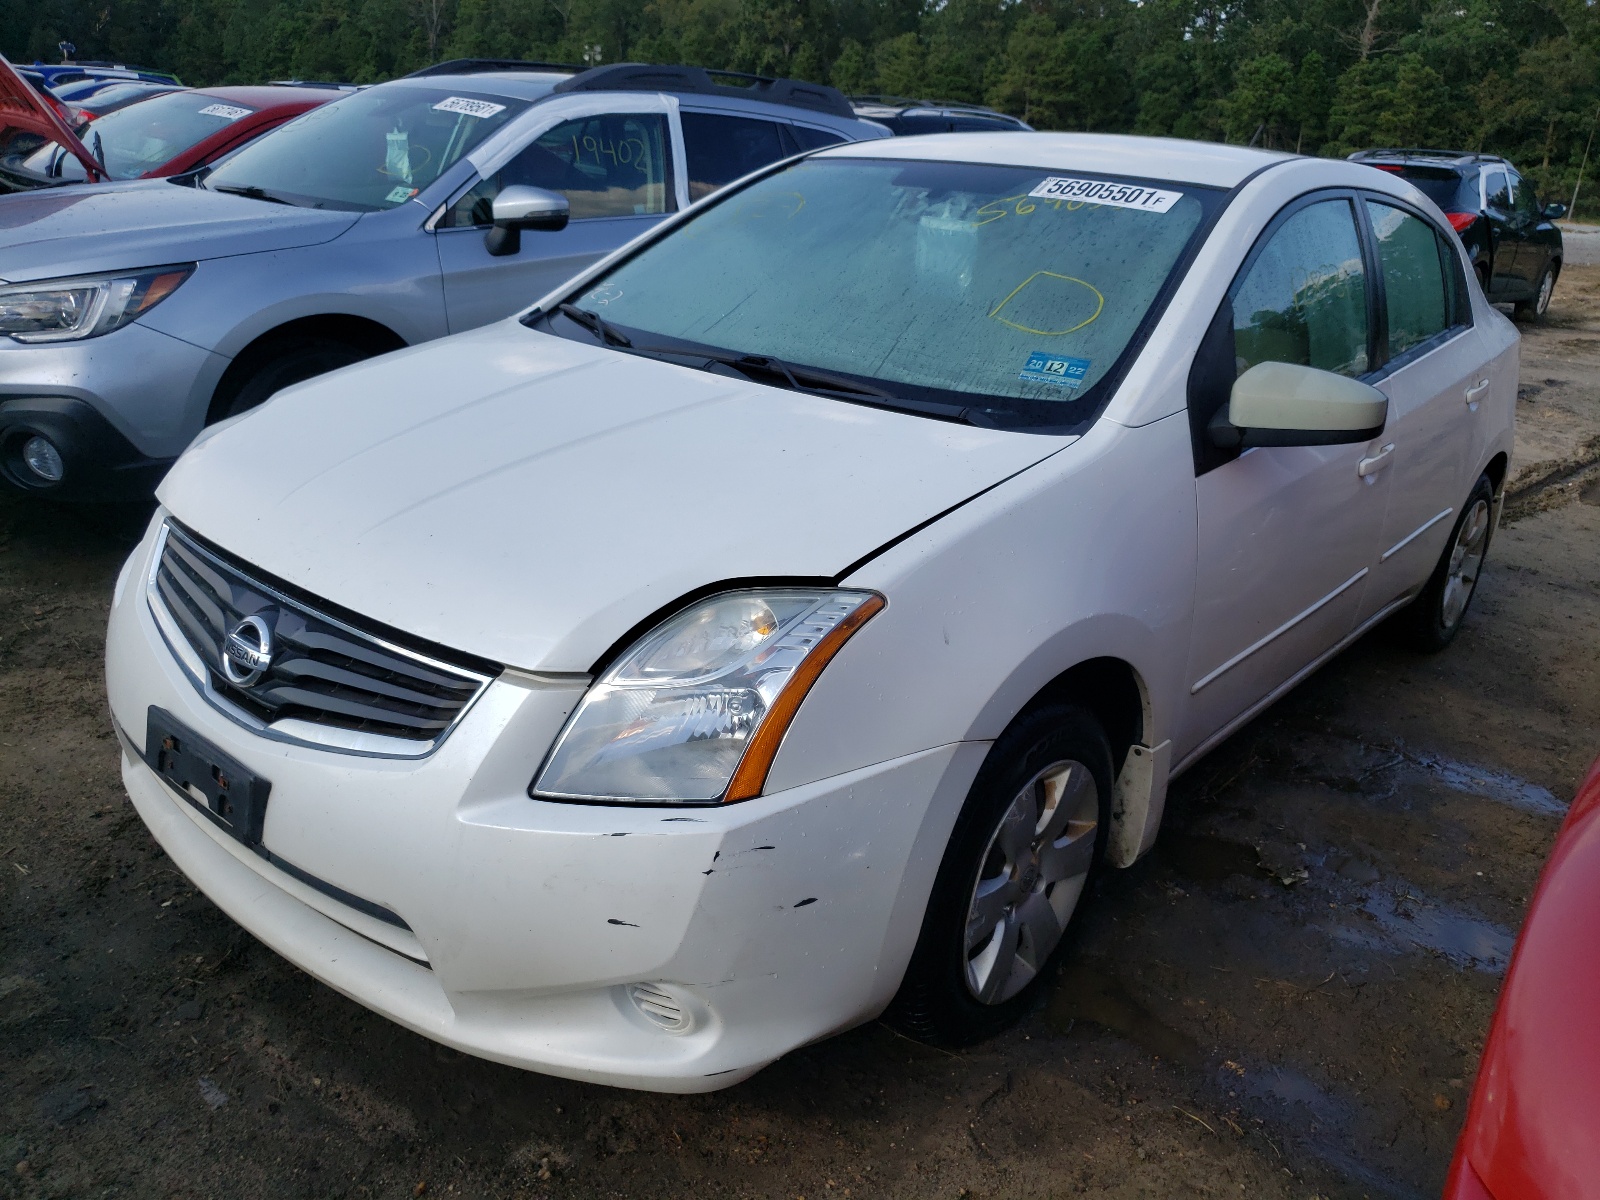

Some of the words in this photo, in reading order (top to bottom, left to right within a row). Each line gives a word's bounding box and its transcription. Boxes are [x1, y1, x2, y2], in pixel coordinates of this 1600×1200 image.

[572, 134, 647, 174] 19402
[1029, 359, 1043, 368] 20
[1046, 362, 1065, 374] 12
[1068, 366, 1085, 375] 22
